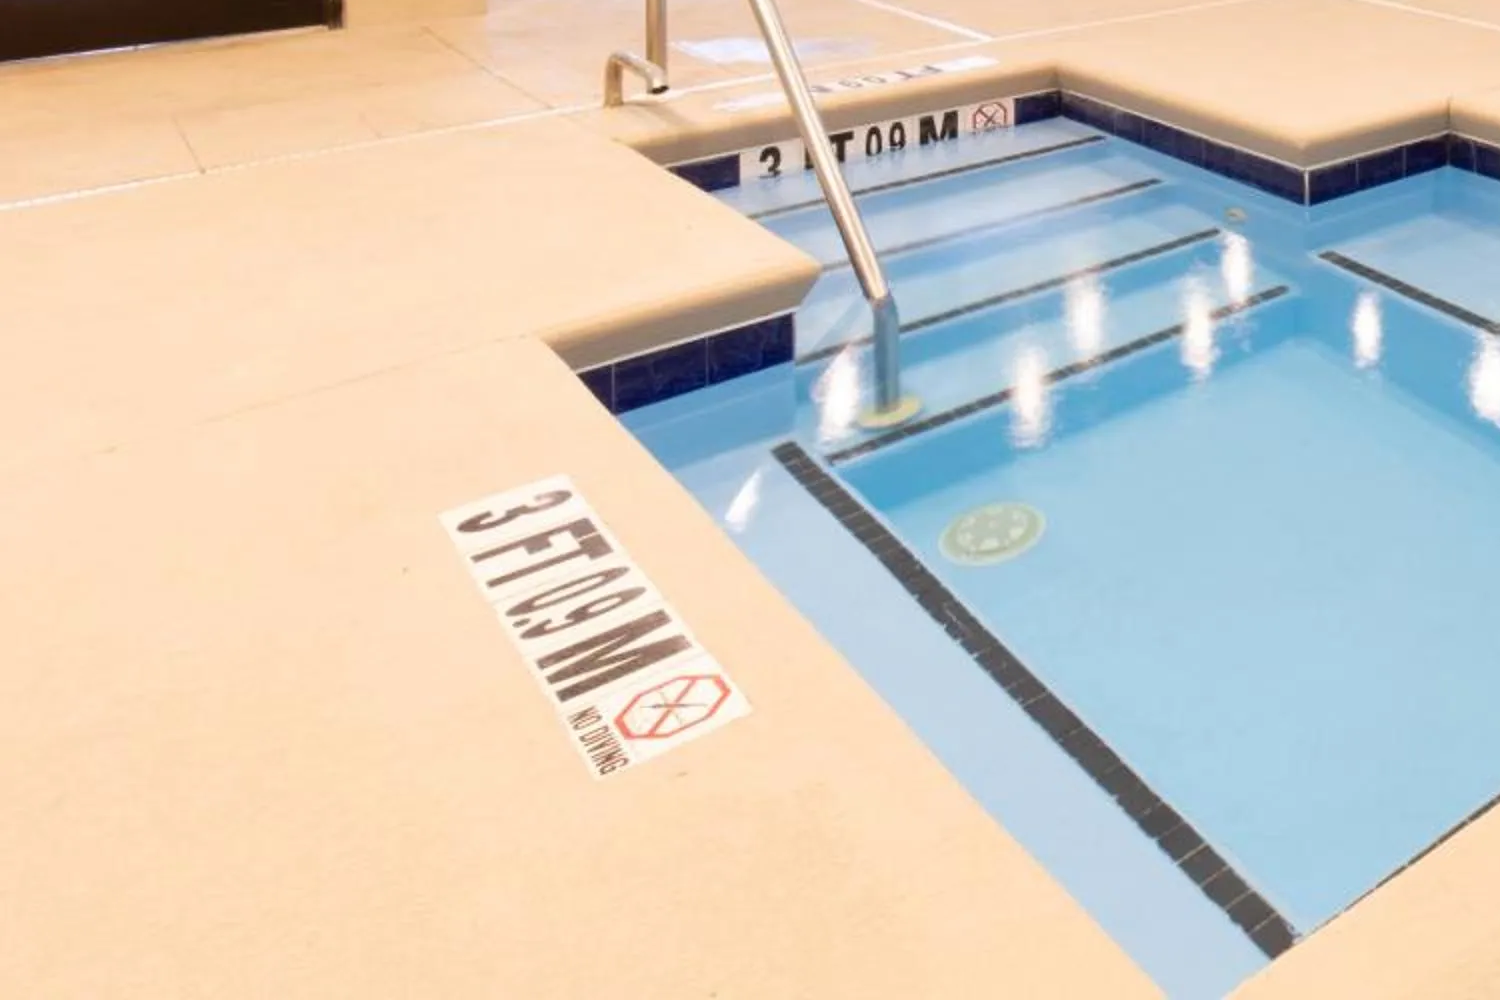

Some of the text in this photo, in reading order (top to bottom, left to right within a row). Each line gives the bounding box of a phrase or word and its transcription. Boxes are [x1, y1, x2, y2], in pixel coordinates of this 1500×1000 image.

[804, 131, 854, 169] T
[920, 110, 958, 145] M
[457, 490, 693, 703] 3 FT 0.9 M
[567, 706, 630, 775] NO DIVING
